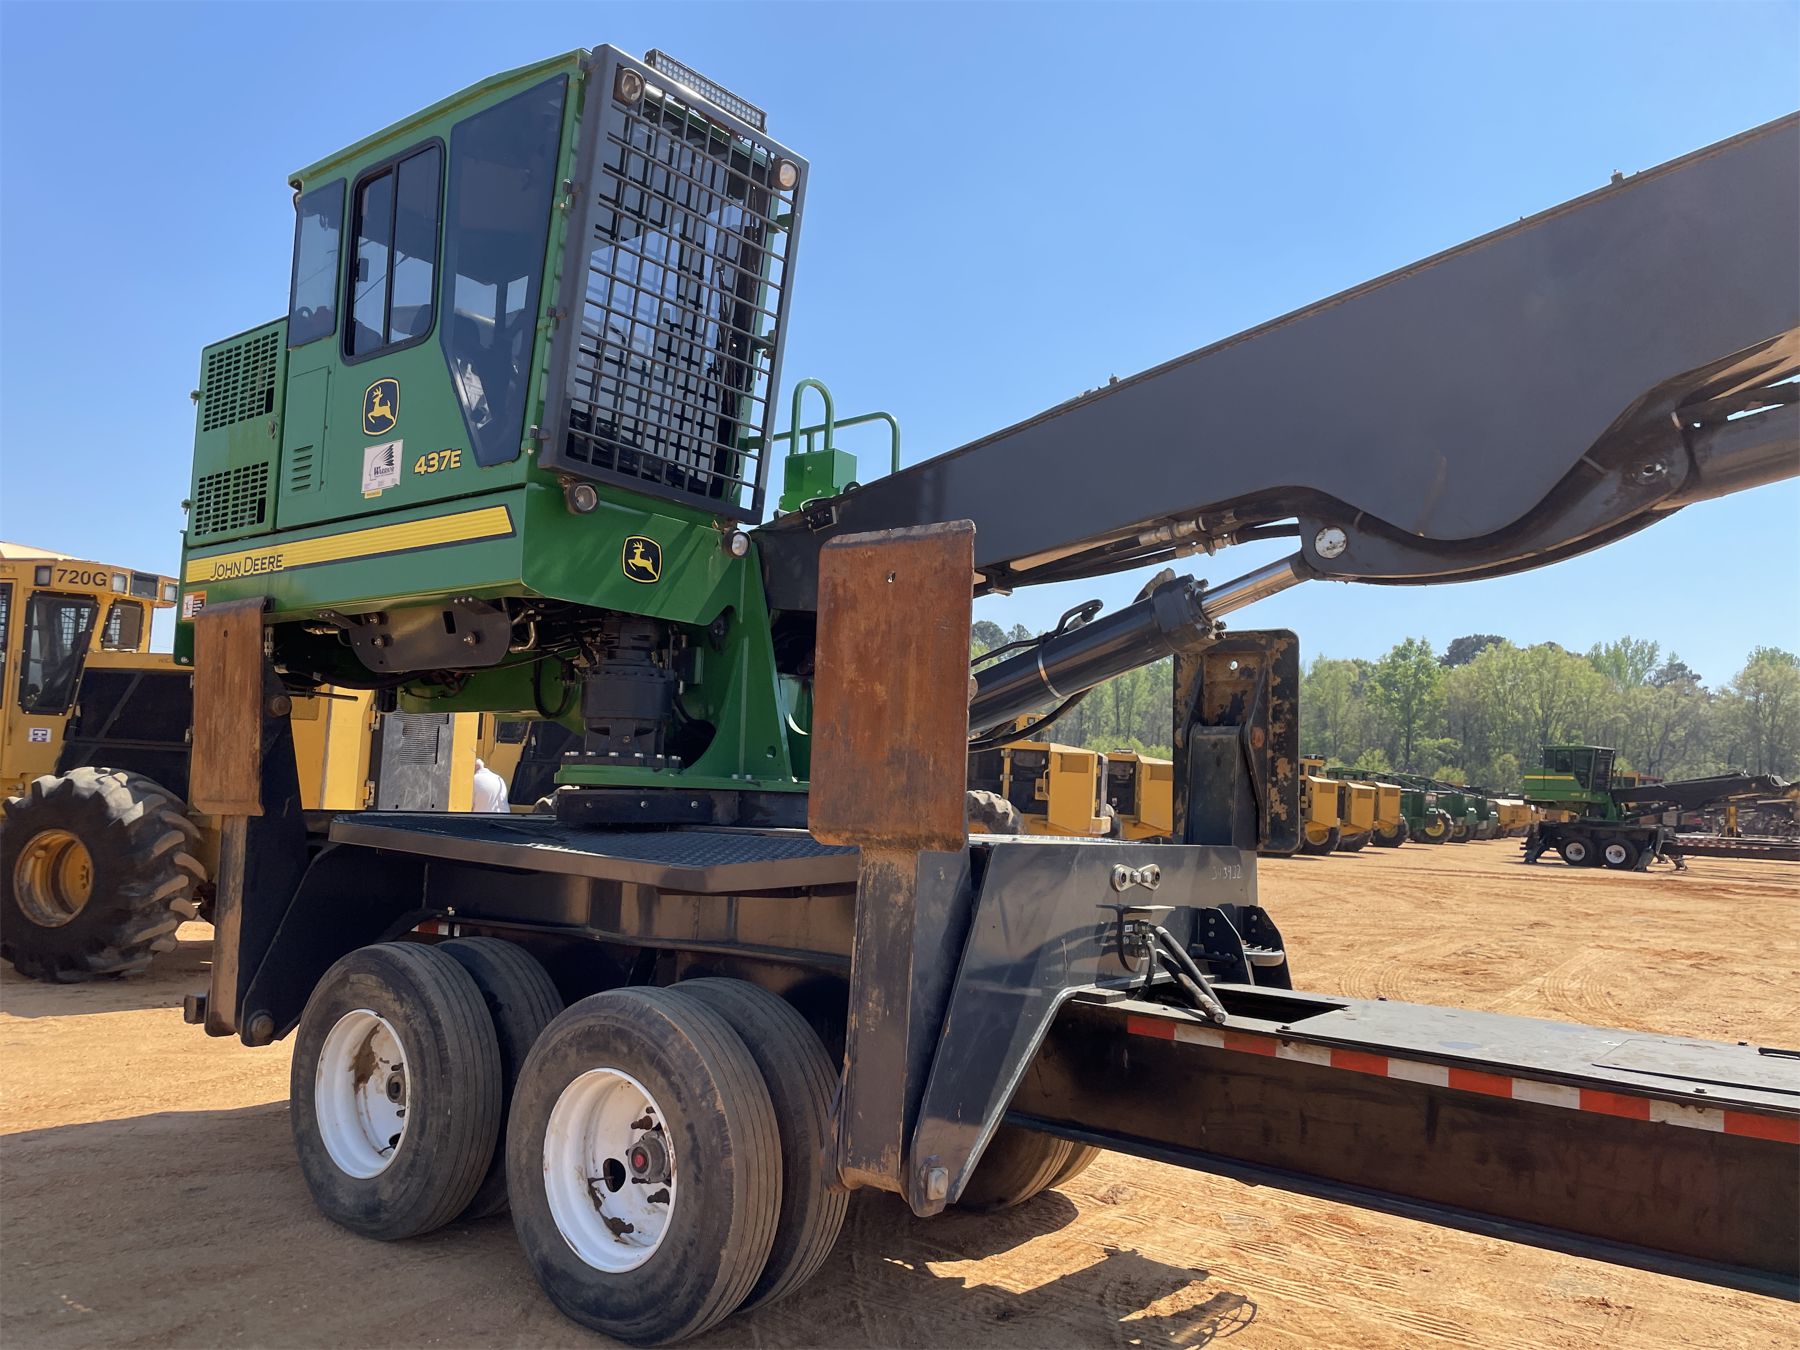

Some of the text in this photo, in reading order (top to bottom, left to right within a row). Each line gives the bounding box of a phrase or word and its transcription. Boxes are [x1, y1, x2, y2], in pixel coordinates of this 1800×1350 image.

[414, 448, 462, 475] 437E
[57, 569, 108, 587] 720G
[210, 554, 284, 579] JOHN DEERE
